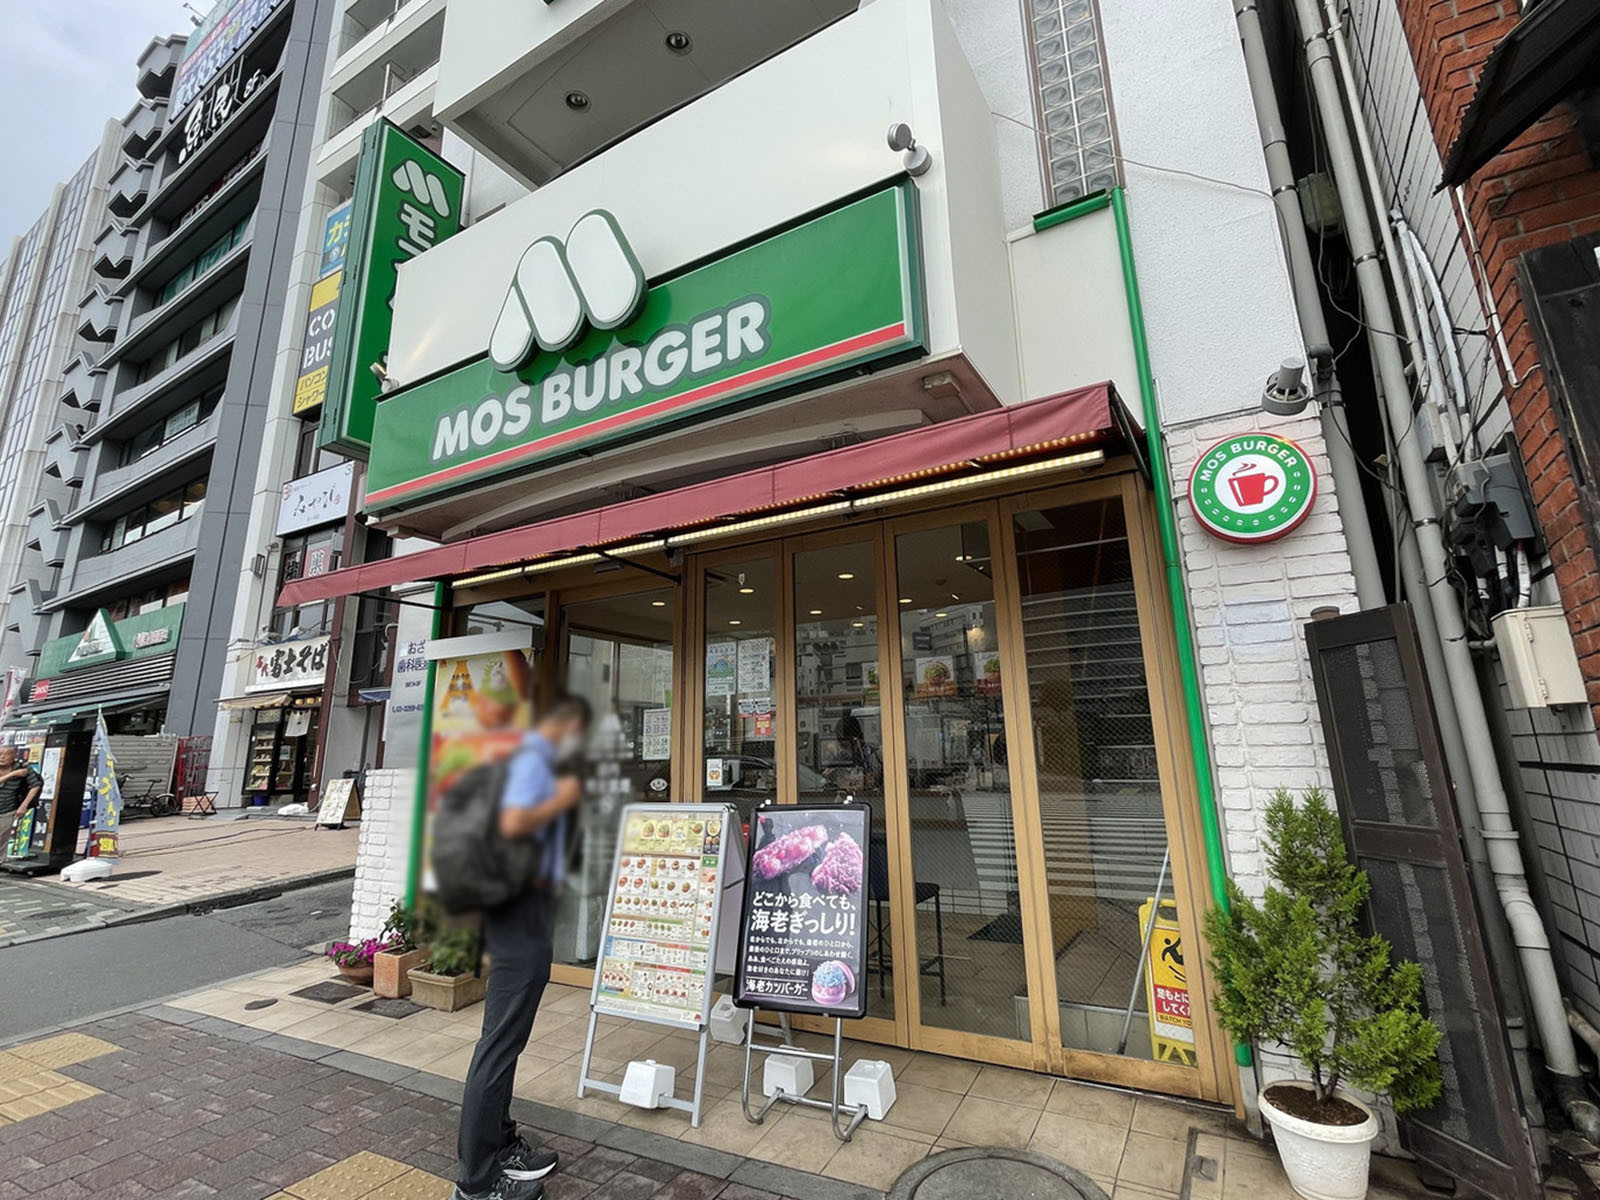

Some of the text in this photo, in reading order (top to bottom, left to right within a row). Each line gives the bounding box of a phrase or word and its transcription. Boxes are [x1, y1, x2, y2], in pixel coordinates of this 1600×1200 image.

[432, 301, 765, 460] MOS BURGER
[1199, 440, 1297, 482] MOS BURGER
[270, 643, 328, 679] 富士そば
[753, 891, 856, 910] どこから食べても、
